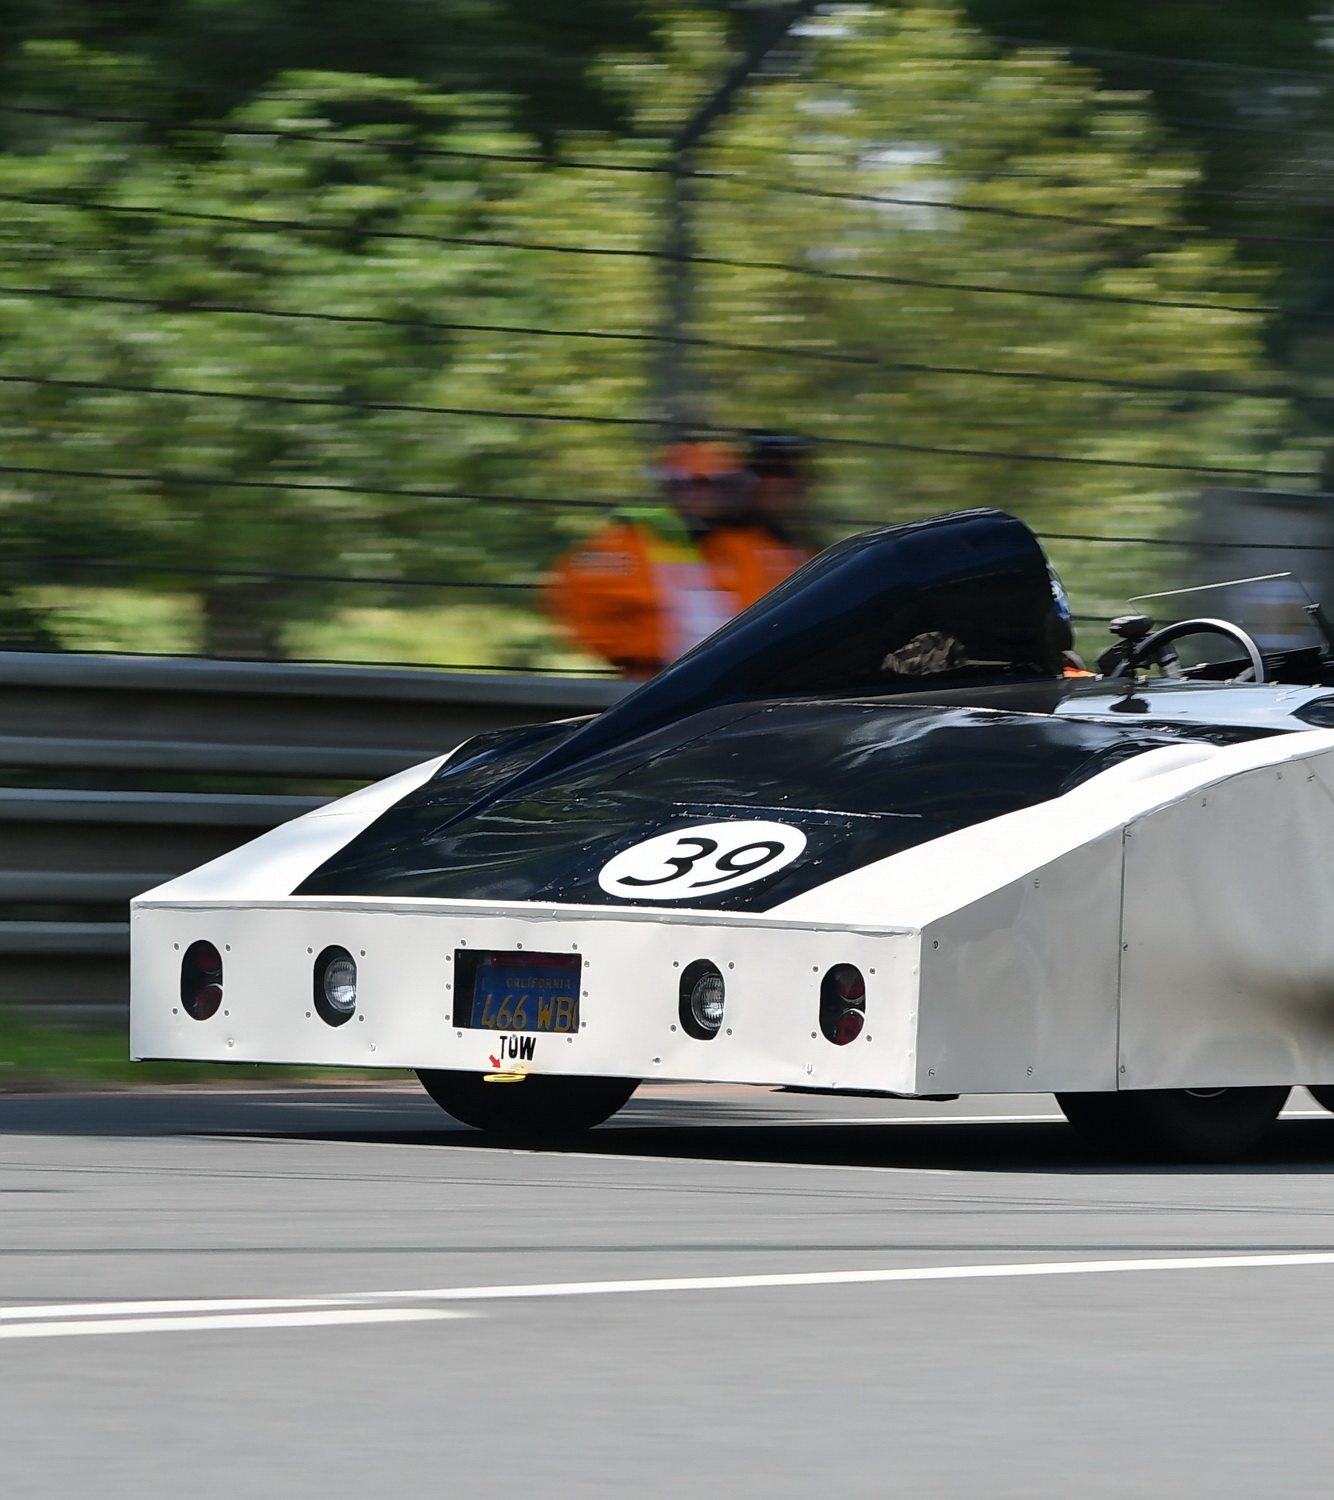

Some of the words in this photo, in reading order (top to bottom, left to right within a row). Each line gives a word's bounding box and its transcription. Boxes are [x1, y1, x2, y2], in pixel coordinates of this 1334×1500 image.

[616, 837, 785, 888] 39
[506, 977, 571, 989] CALIFORNIA
[481, 994, 528, 1031] 466
[499, 1035, 537, 1061] TOW
